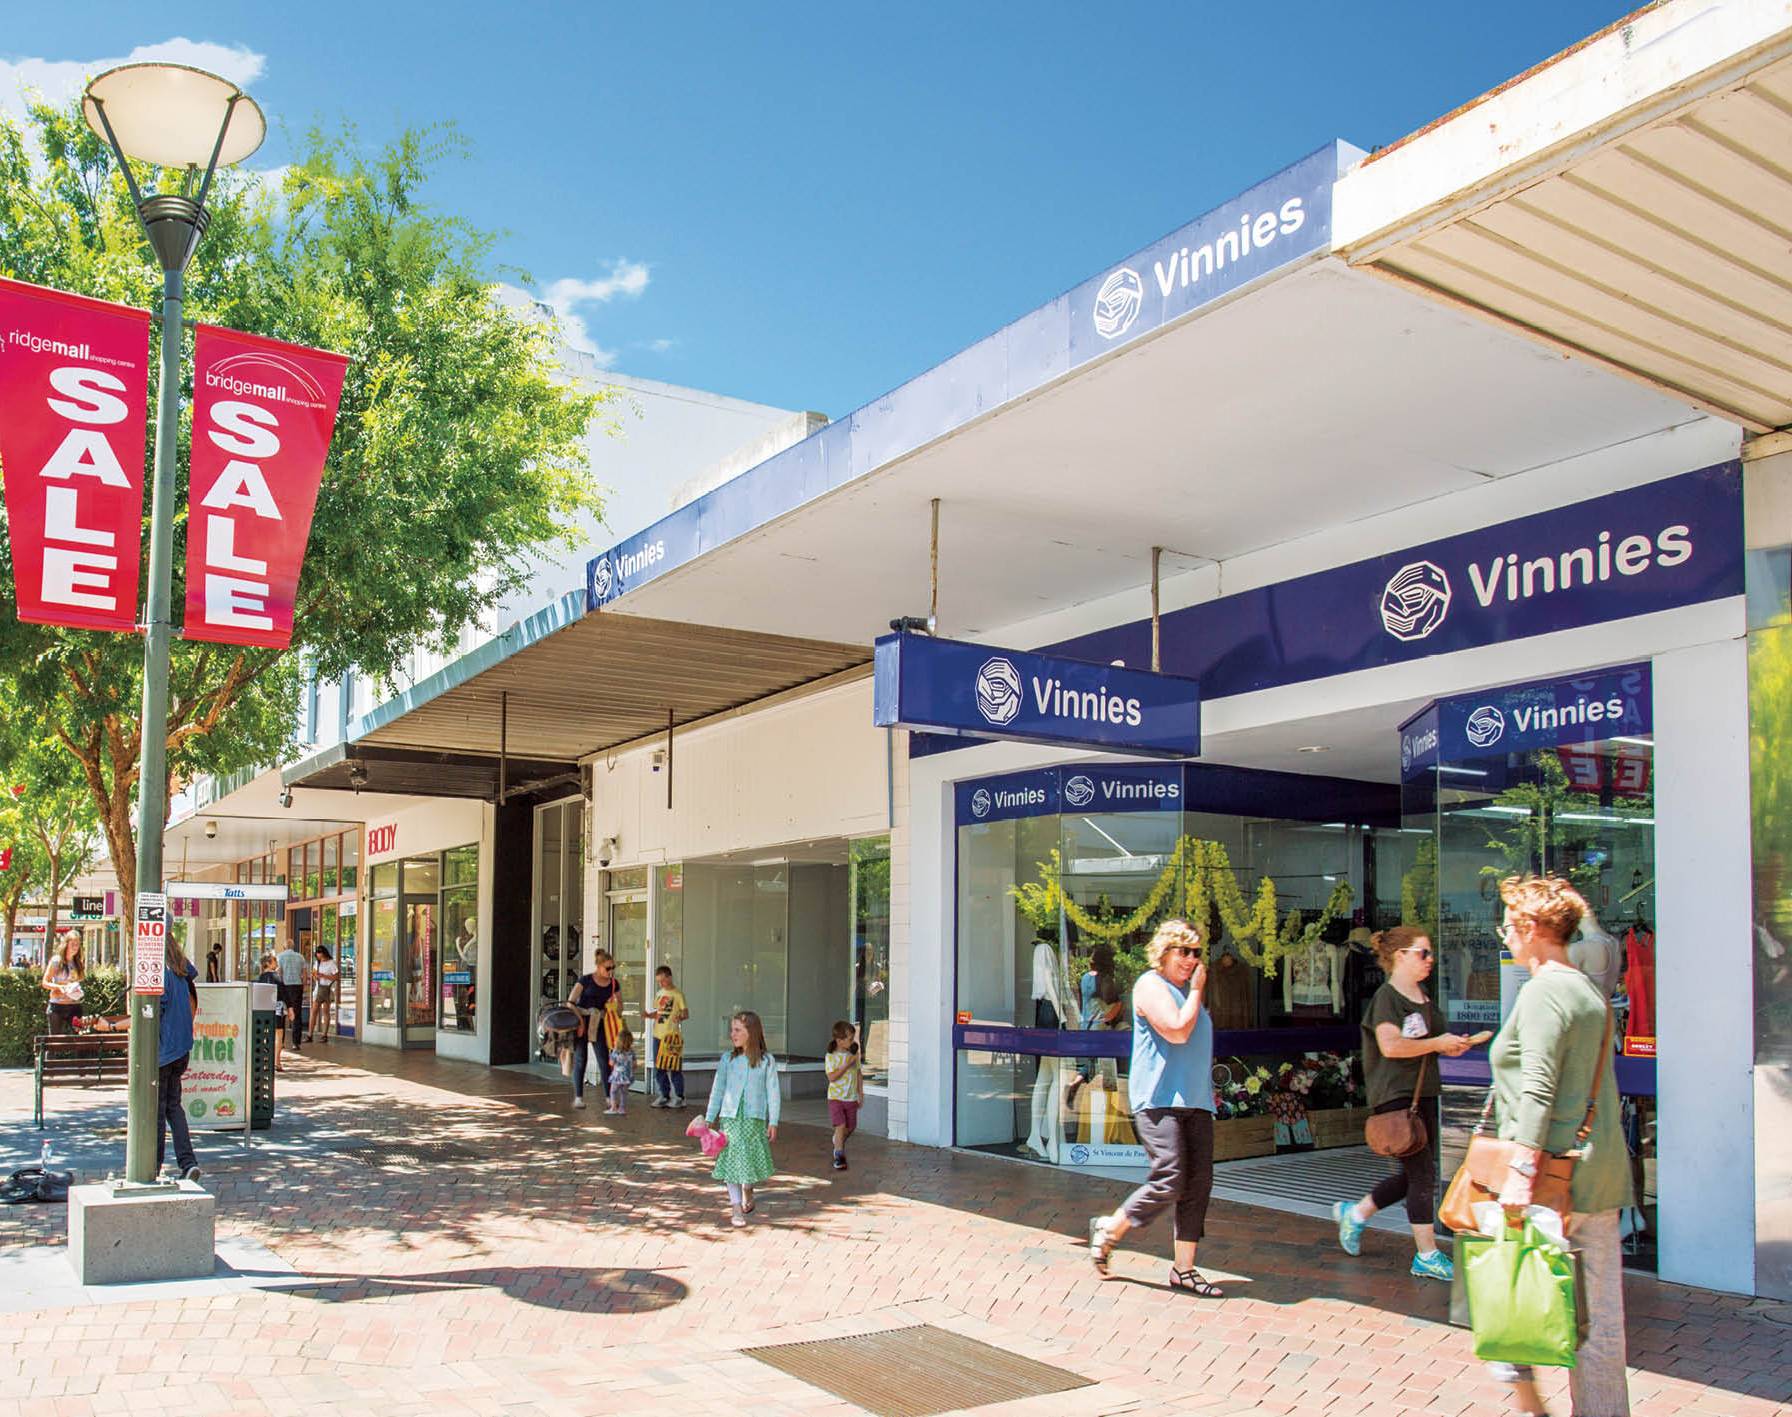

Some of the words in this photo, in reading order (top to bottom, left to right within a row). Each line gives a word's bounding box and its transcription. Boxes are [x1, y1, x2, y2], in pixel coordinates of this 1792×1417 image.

[1153, 197, 1305, 297] Vinnies
[206, 370, 286, 402] bridgemall
[39, 366, 132, 612] SALE
[200, 400, 283, 631] SALE
[615, 540, 665, 580] Vinnies
[1468, 525, 1693, 607] Vinnies
[1032, 676, 1142, 727] Vinnies
[1513, 698, 1624, 732] Vinnies
[1411, 729, 1438, 758] Vinnies
[994, 786, 1045, 809] Vinnies
[1102, 780, 1180, 799] Vinnies
[368, 823, 398, 856] BODY
[224, 887, 246, 897] Tatts
[138, 922, 164, 937] NO
[192, 1035, 235, 1062] rket
[180, 1068, 238, 1085] Saturday
